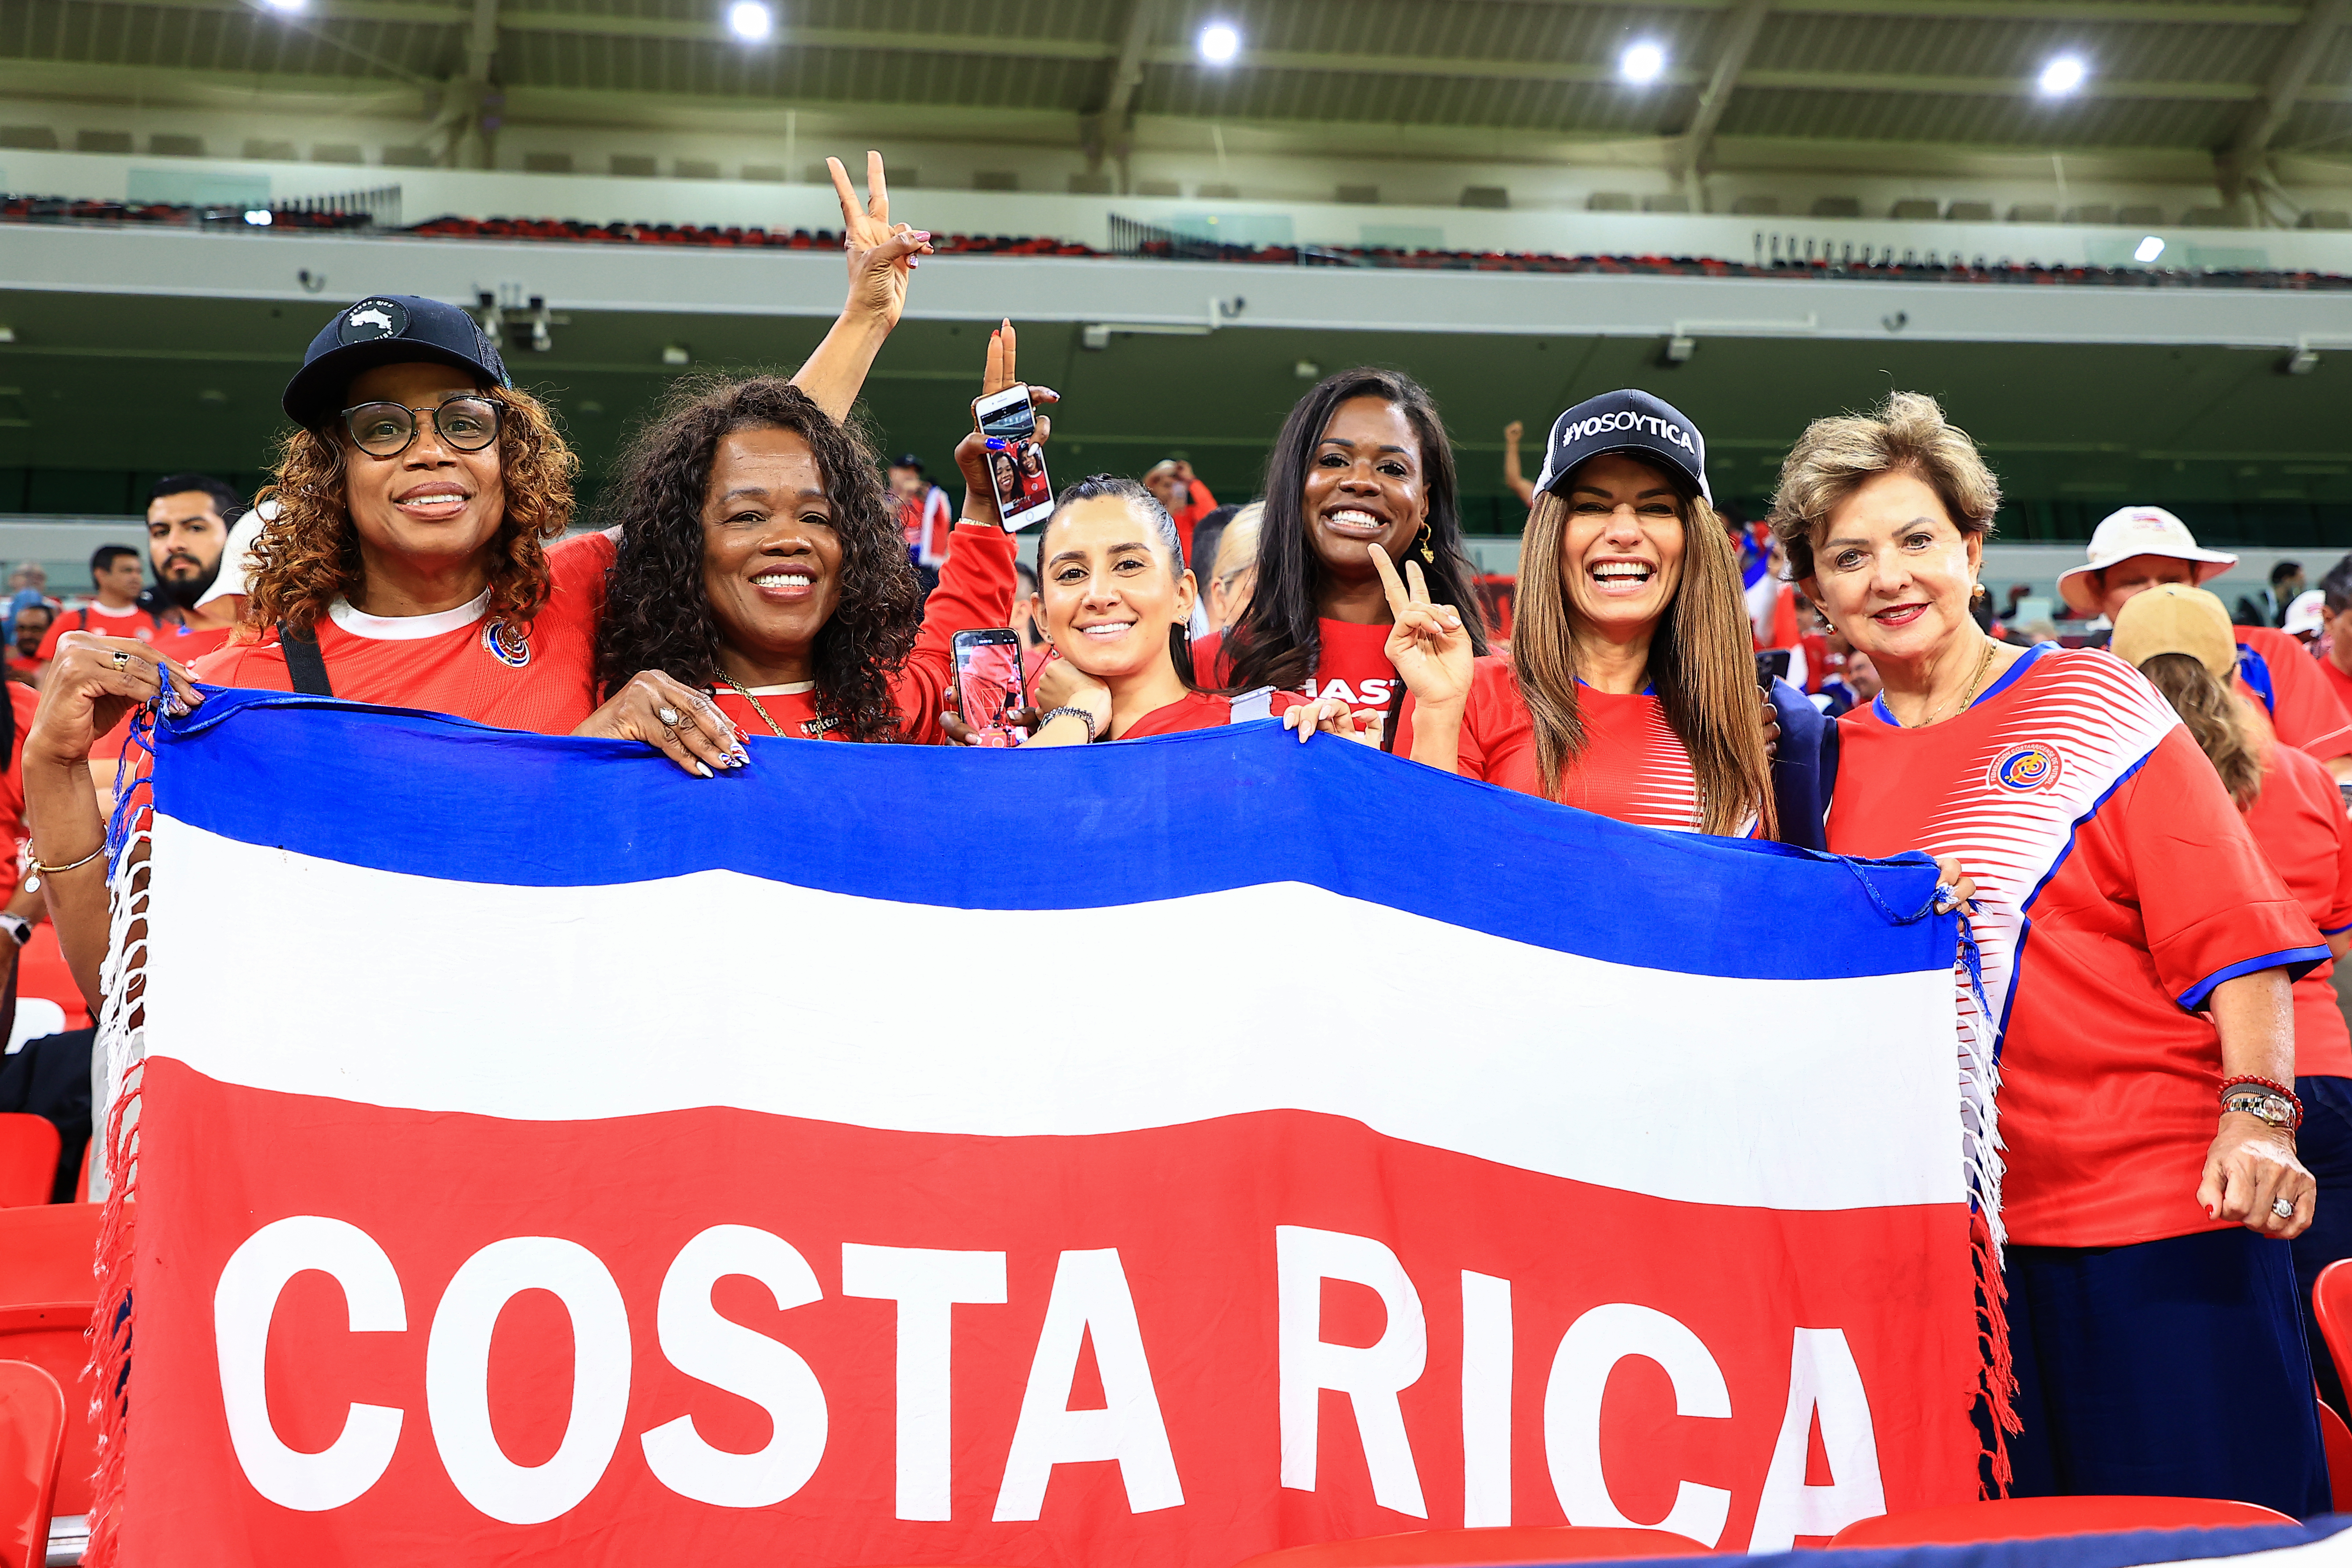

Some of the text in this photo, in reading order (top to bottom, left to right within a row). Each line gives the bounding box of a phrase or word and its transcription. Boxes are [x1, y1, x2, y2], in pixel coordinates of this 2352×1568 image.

[1562, 411, 1695, 455] #YOSOYTICA
[1990, 744, 2059, 786] FEDERACION COSTARRICENSE DE FUTBOL
[213, 1215, 1888, 1556] COSTA RICA
